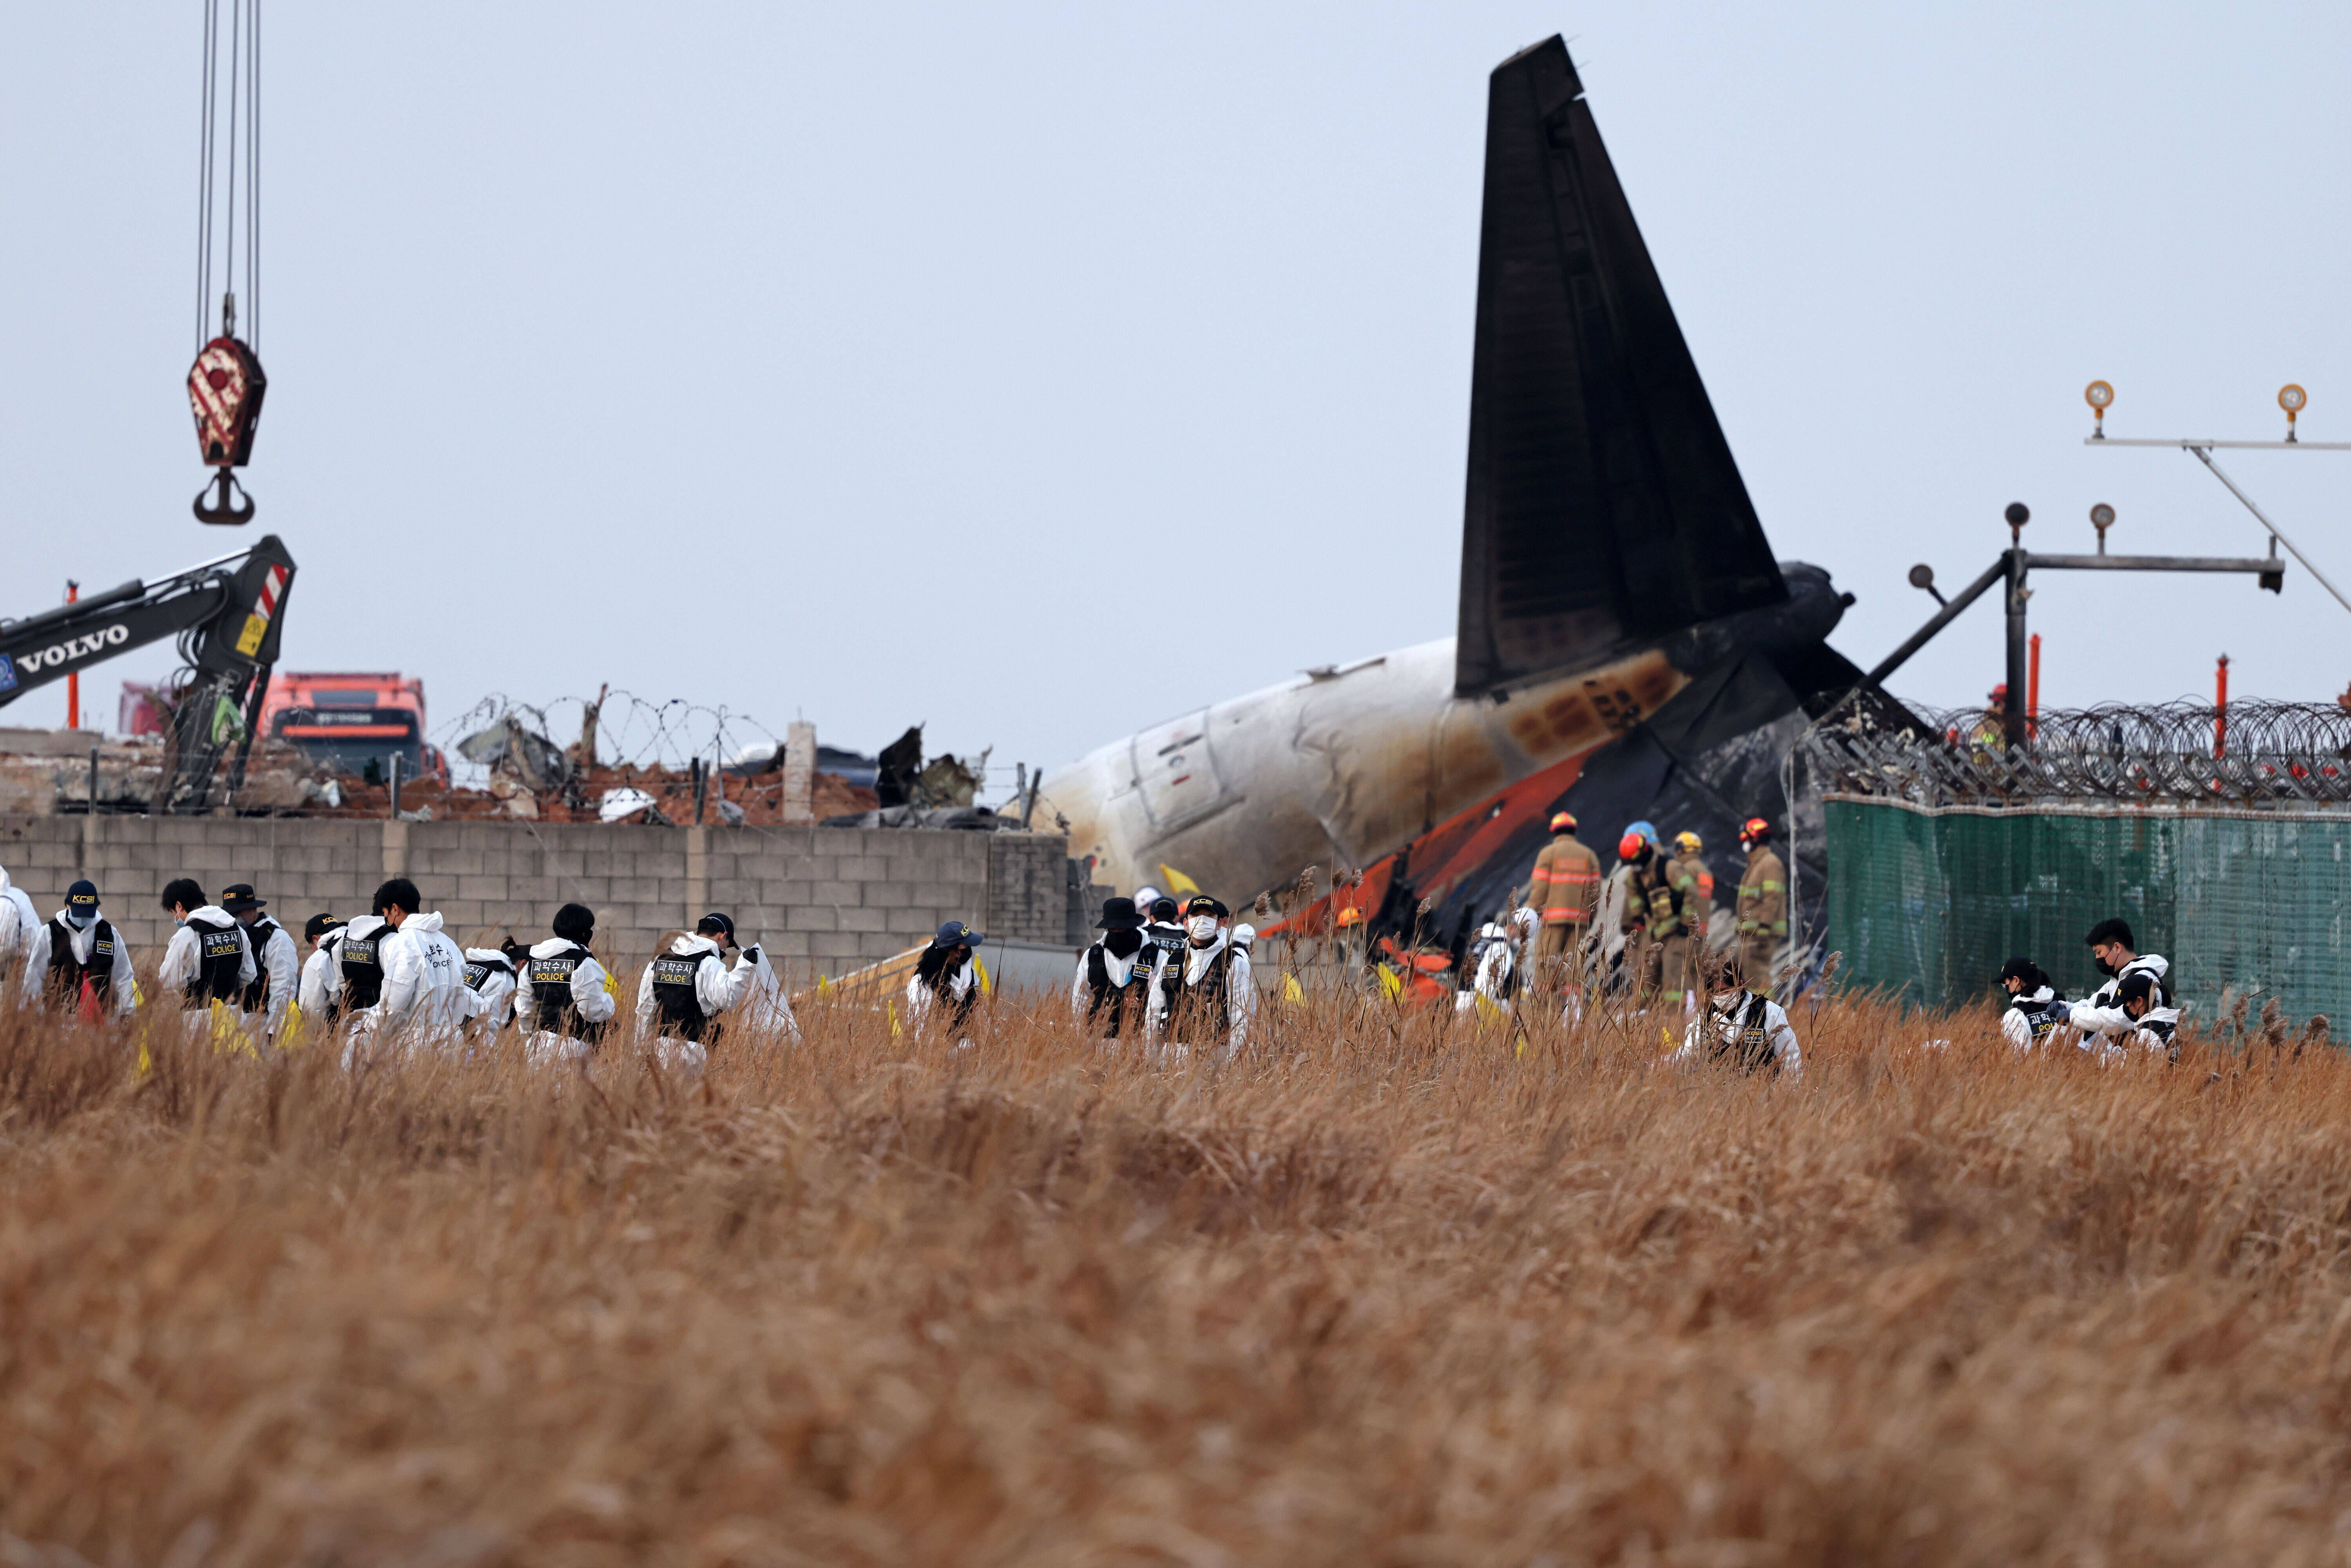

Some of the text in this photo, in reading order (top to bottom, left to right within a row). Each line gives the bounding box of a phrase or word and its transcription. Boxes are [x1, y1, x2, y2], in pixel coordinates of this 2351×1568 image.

[16, 624, 129, 673] VOLVO
[960, 925, 969, 936] KC
[206, 933, 237, 946] 과학수사
[212, 944, 236, 954] POLICE
[344, 940, 373, 953] 과학수사
[346, 952, 368, 961] POLICE
[534, 961, 571, 972] 과학수사
[659, 962, 692, 974] 과학수사
[660, 974, 686, 983] POLICE
[2030, 1013, 2050, 1024] 과학
